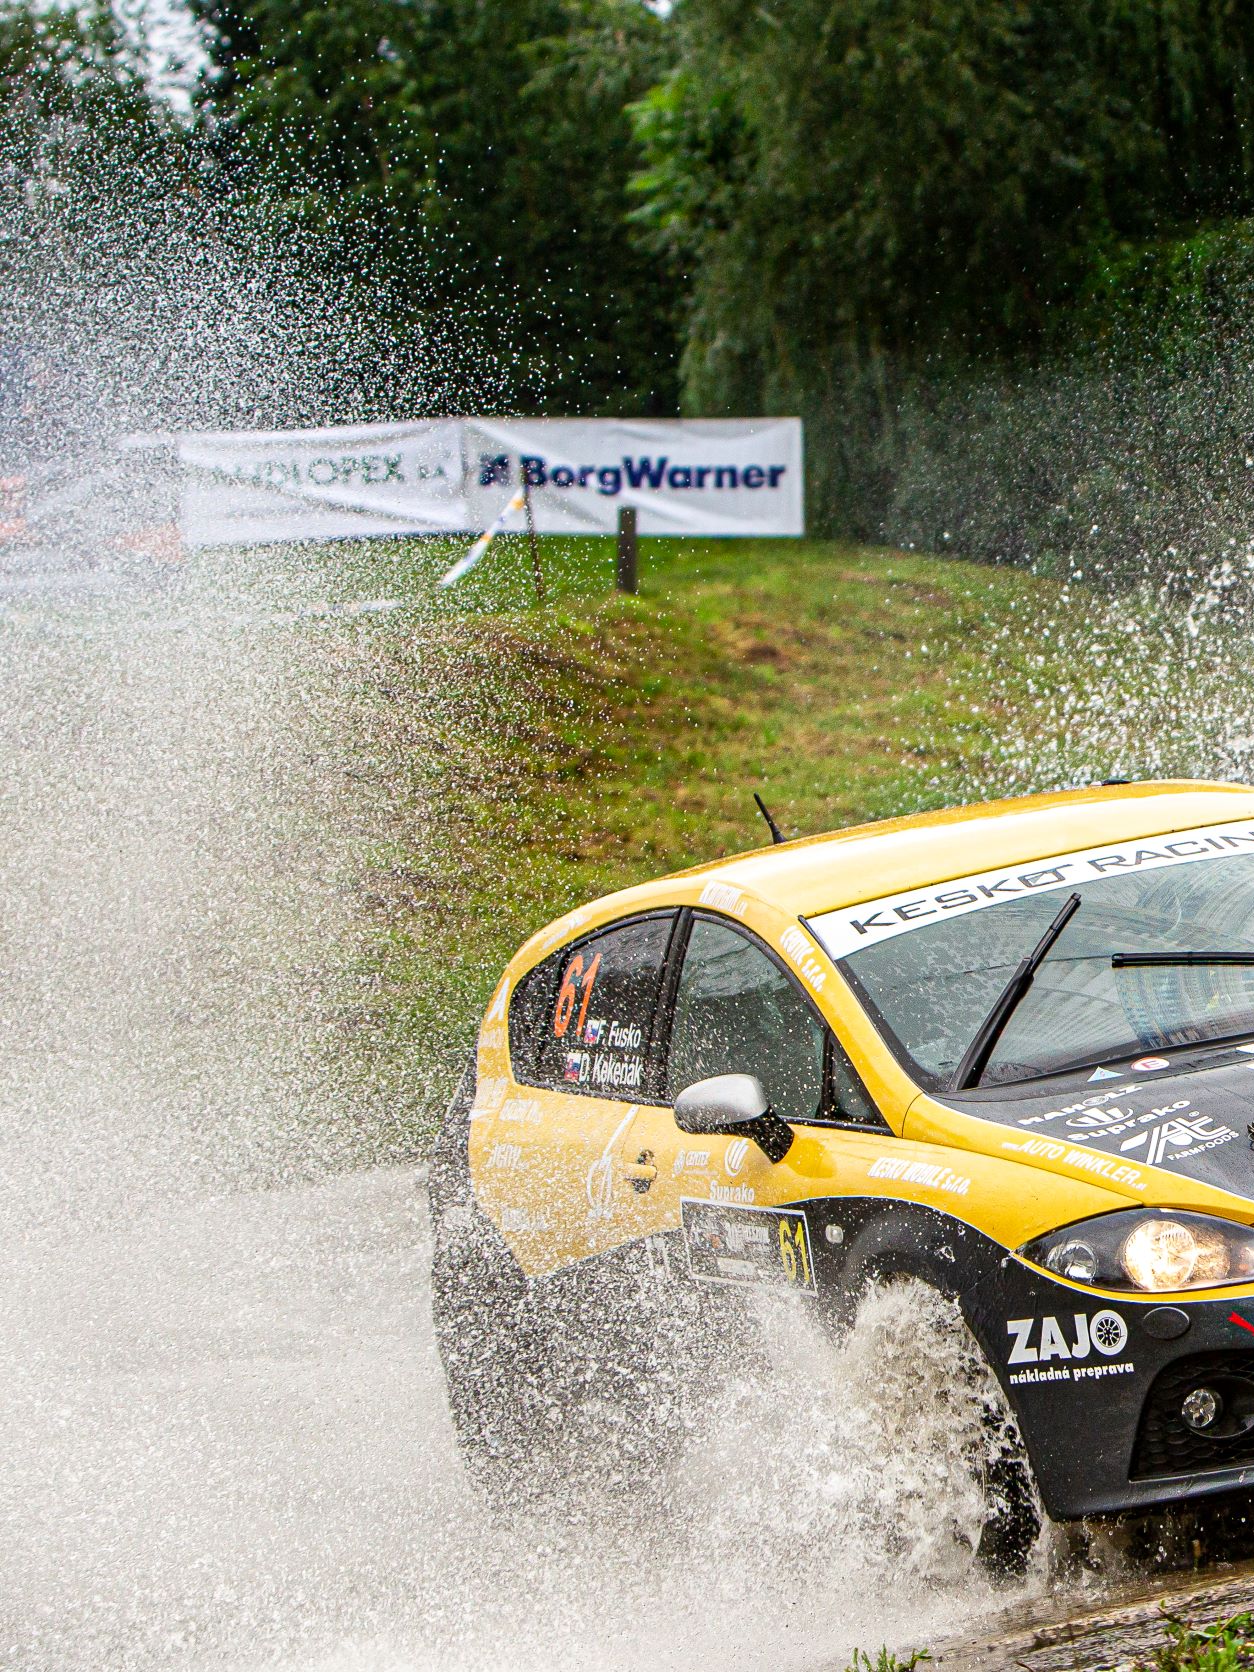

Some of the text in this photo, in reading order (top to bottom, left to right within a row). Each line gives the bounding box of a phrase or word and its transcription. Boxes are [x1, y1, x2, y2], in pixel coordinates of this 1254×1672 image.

[519, 454, 787, 497] BorgWarner
[849, 864, 1072, 935] KESKO
[555, 952, 602, 1038] 61
[1068, 1100, 1191, 1142] Suprako
[1167, 1130, 1240, 1161] FARMFOODS
[779, 1219, 810, 1284] 61
[1007, 1309, 1128, 1364] ZAJO
[1009, 1360, 1135, 1385] nákladná preprava
